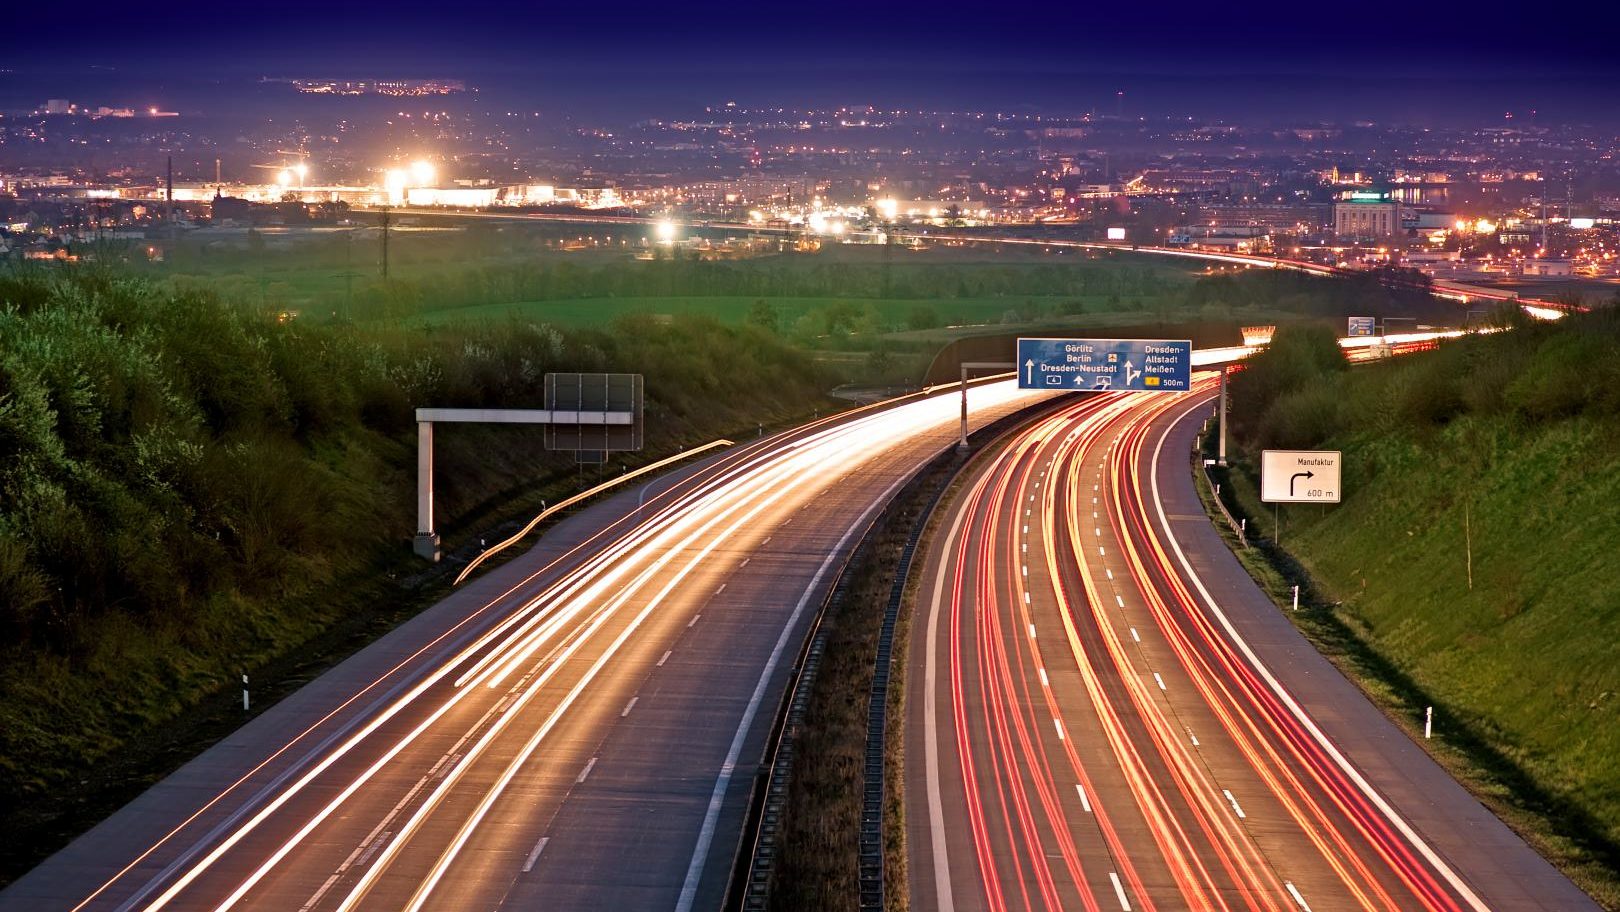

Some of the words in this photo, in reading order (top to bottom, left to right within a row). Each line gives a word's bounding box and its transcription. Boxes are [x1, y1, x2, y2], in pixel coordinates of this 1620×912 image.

[1065, 344, 1093, 353] Görlitz
[1145, 345, 1184, 354] Dresden-
[1066, 354, 1092, 363] Berlin
[1145, 355, 1178, 364] Altstadt
[1041, 363, 1118, 373] Dresden-Neustadt
[1144, 365, 1175, 374] Meißen
[1297, 457, 1334, 466] Manufaktur
[1307, 489, 1322, 497] 600
